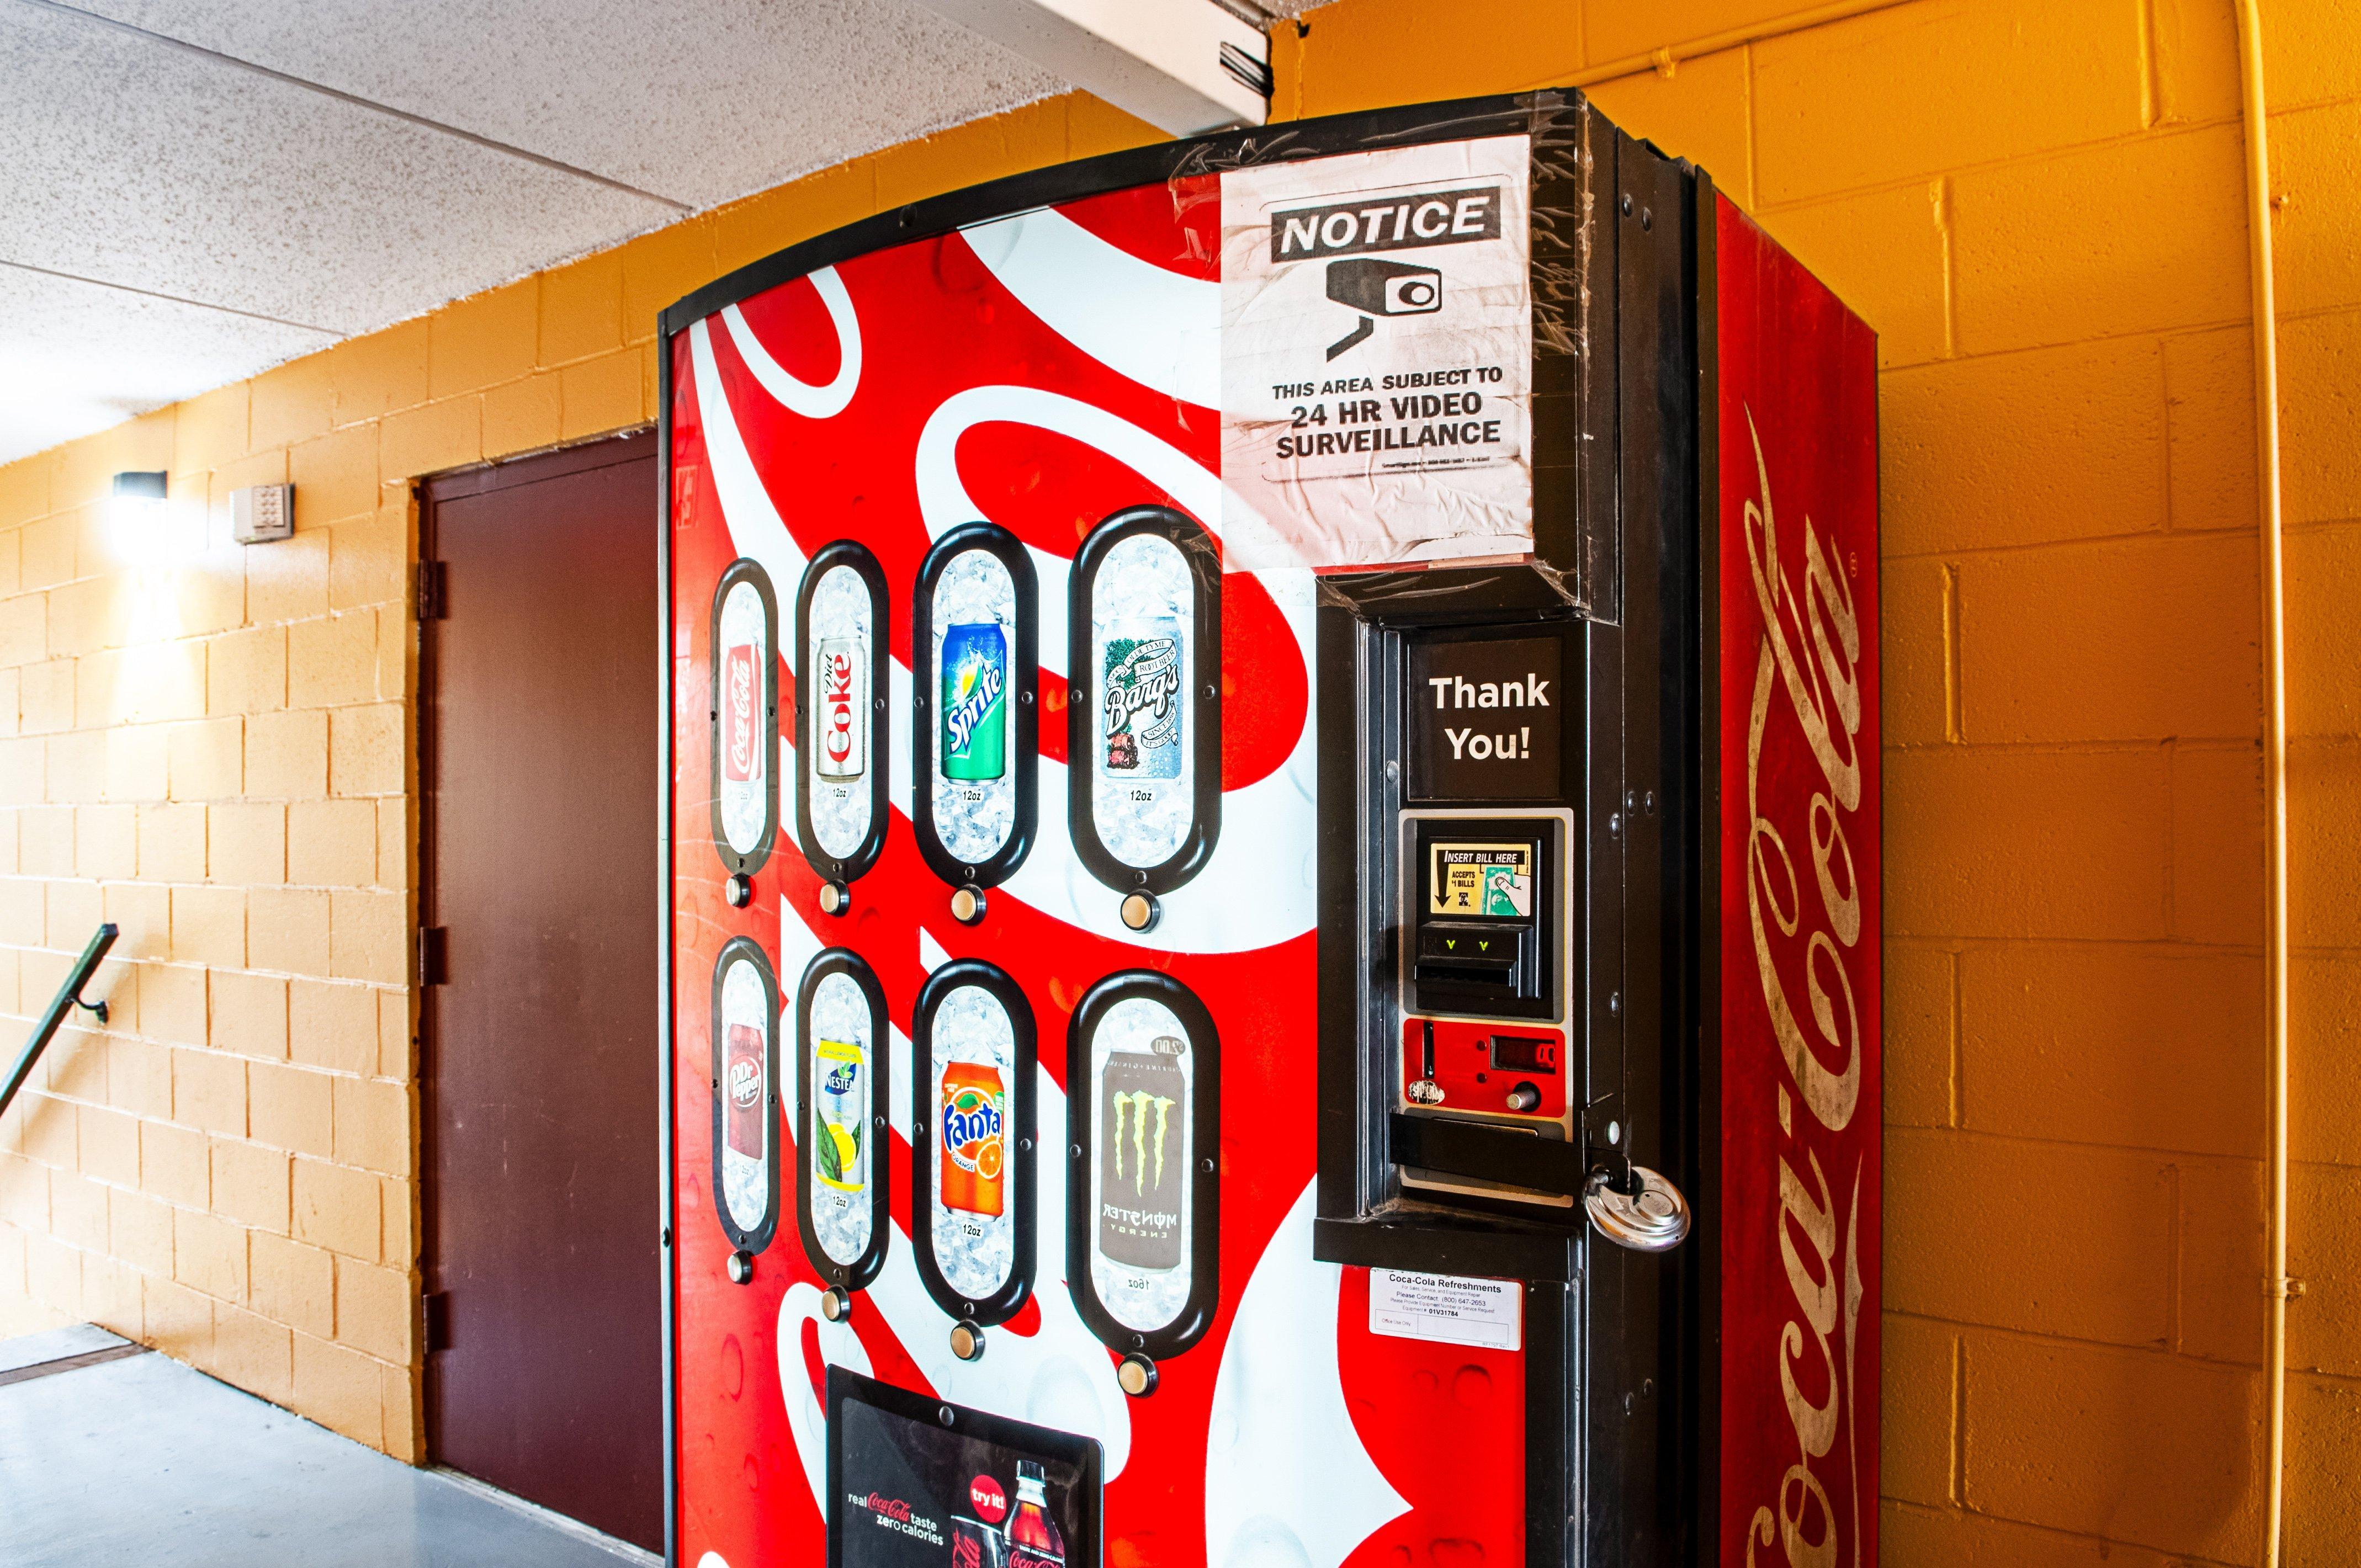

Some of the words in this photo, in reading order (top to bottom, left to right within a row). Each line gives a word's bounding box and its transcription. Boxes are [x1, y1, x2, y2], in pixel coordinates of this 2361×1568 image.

[1280, 195, 1490, 253] NOTICE
[1272, 382, 1314, 400] THIS
[1320, 378, 1373, 395] AREA
[1382, 369, 1470, 390] SUBJECT
[1476, 366, 1503, 383] TO
[1291, 404, 1327, 428] 24
[1339, 399, 1382, 424] HR
[1390, 391, 1482, 419] VIDEO
[1276, 420, 1501, 459] SURVEILLANCE
[1139, 662, 1158, 673] ROOT
[1159, 650, 1175, 666] BEER
[823, 654, 832, 694] Diet
[1105, 664, 1179, 740] Barq's
[1429, 673, 1550, 709] Thank
[827, 655, 851, 763] Coke
[948, 664, 1001, 756] Sprite
[1148, 722, 1166, 737] SINCE
[1444, 727, 1530, 760] You!
[832, 788, 846, 798] 12oz
[963, 790, 981, 801] 12oz
[1130, 790, 1152, 802] 12oz
[1476, 853, 1493, 863] BILL
[1495, 854, 1517, 863] HERE
[730, 1065, 760, 1101] Pepper
[740, 1062, 753, 1082] Dr
[826, 1073, 855, 1092] NESTEA
[952, 1154, 974, 1171] ORANGE
[833, 1196, 846, 1207] 12oz
[962, 1224, 981, 1237] 12oz
[1389, 1274, 1435, 1286] Coca-Cola
[1438, 1279, 1502, 1293] Refreshments
[1429, 1308, 1458, 1317] 01V31784
[1458, 1298, 1486, 1306] 647-2653
[971, 1488, 991, 1507] try
[991, 1492, 1005, 1510] it!
[848, 1493, 867, 1507] real
[911, 1513, 937, 1532] taste
[877, 1514, 901, 1530] zero
[902, 1524, 943, 1546] calories
